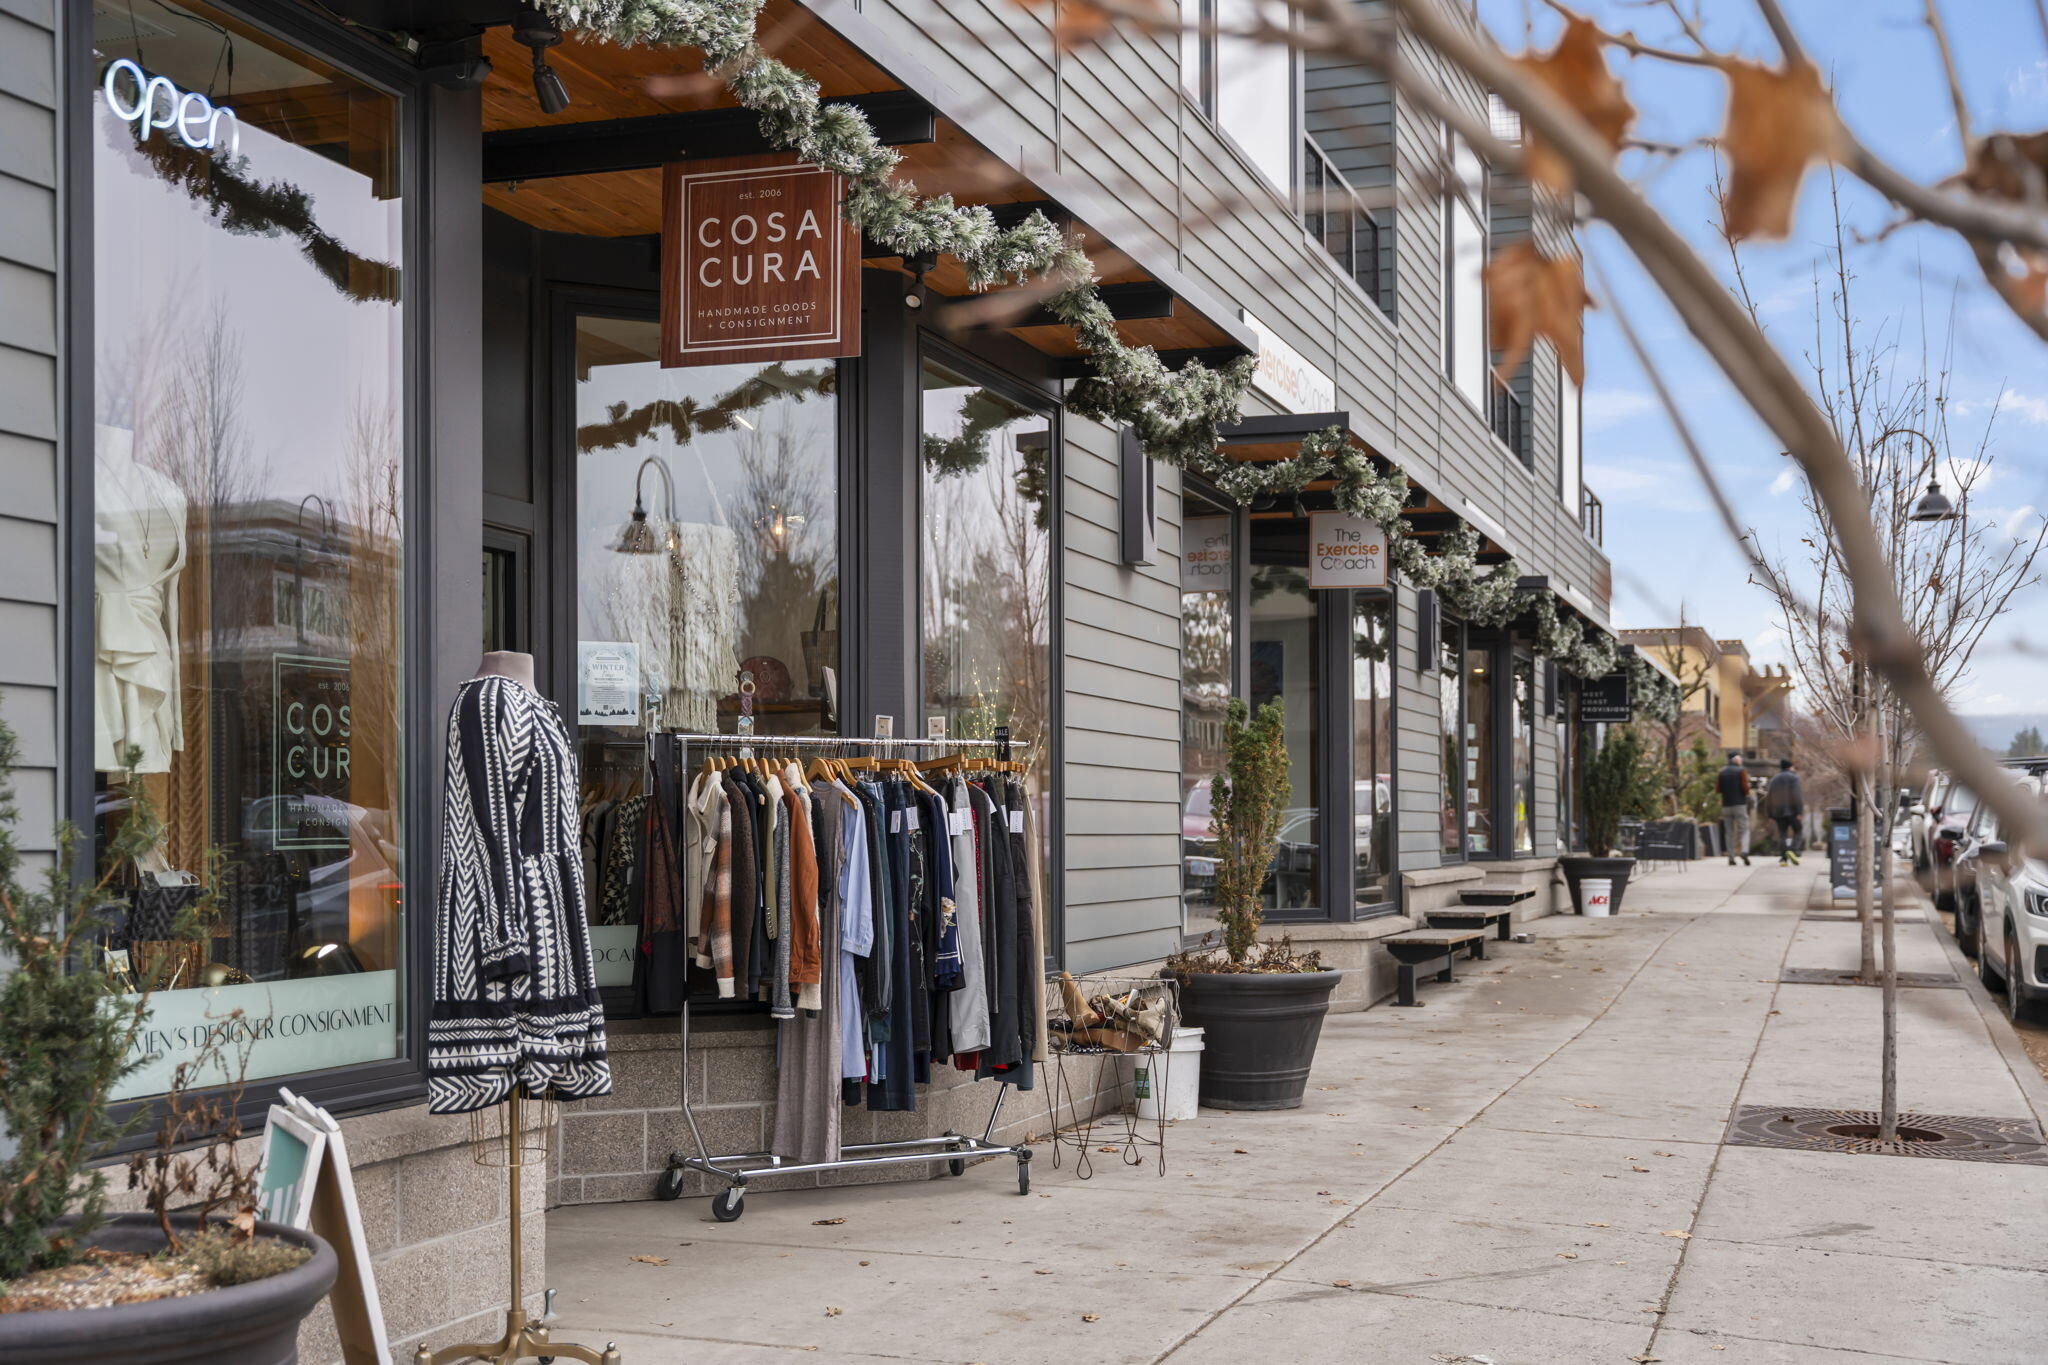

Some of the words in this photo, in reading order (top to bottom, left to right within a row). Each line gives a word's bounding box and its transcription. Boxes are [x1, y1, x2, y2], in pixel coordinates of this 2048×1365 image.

[759, 189, 782, 199] 2006
[698, 209, 822, 248] COSA
[699, 250, 821, 288] CURA
[698, 304, 768, 318] HANDMADE
[773, 301, 817, 313] GOODS
[719, 314, 812, 330] CONSIGNMENT
[1335, 528, 1361, 542] The
[1317, 542, 1379, 557] Exercise
[592, 663, 625, 671] WINTER
[286, 701, 350, 738] COS
[287, 745, 350, 779] CUR
[305, 818, 348, 827] CONSIGN
[193, 1018, 275, 1049] DESIGNER
[279, 1002, 393, 1038] CONSIGNMENT
